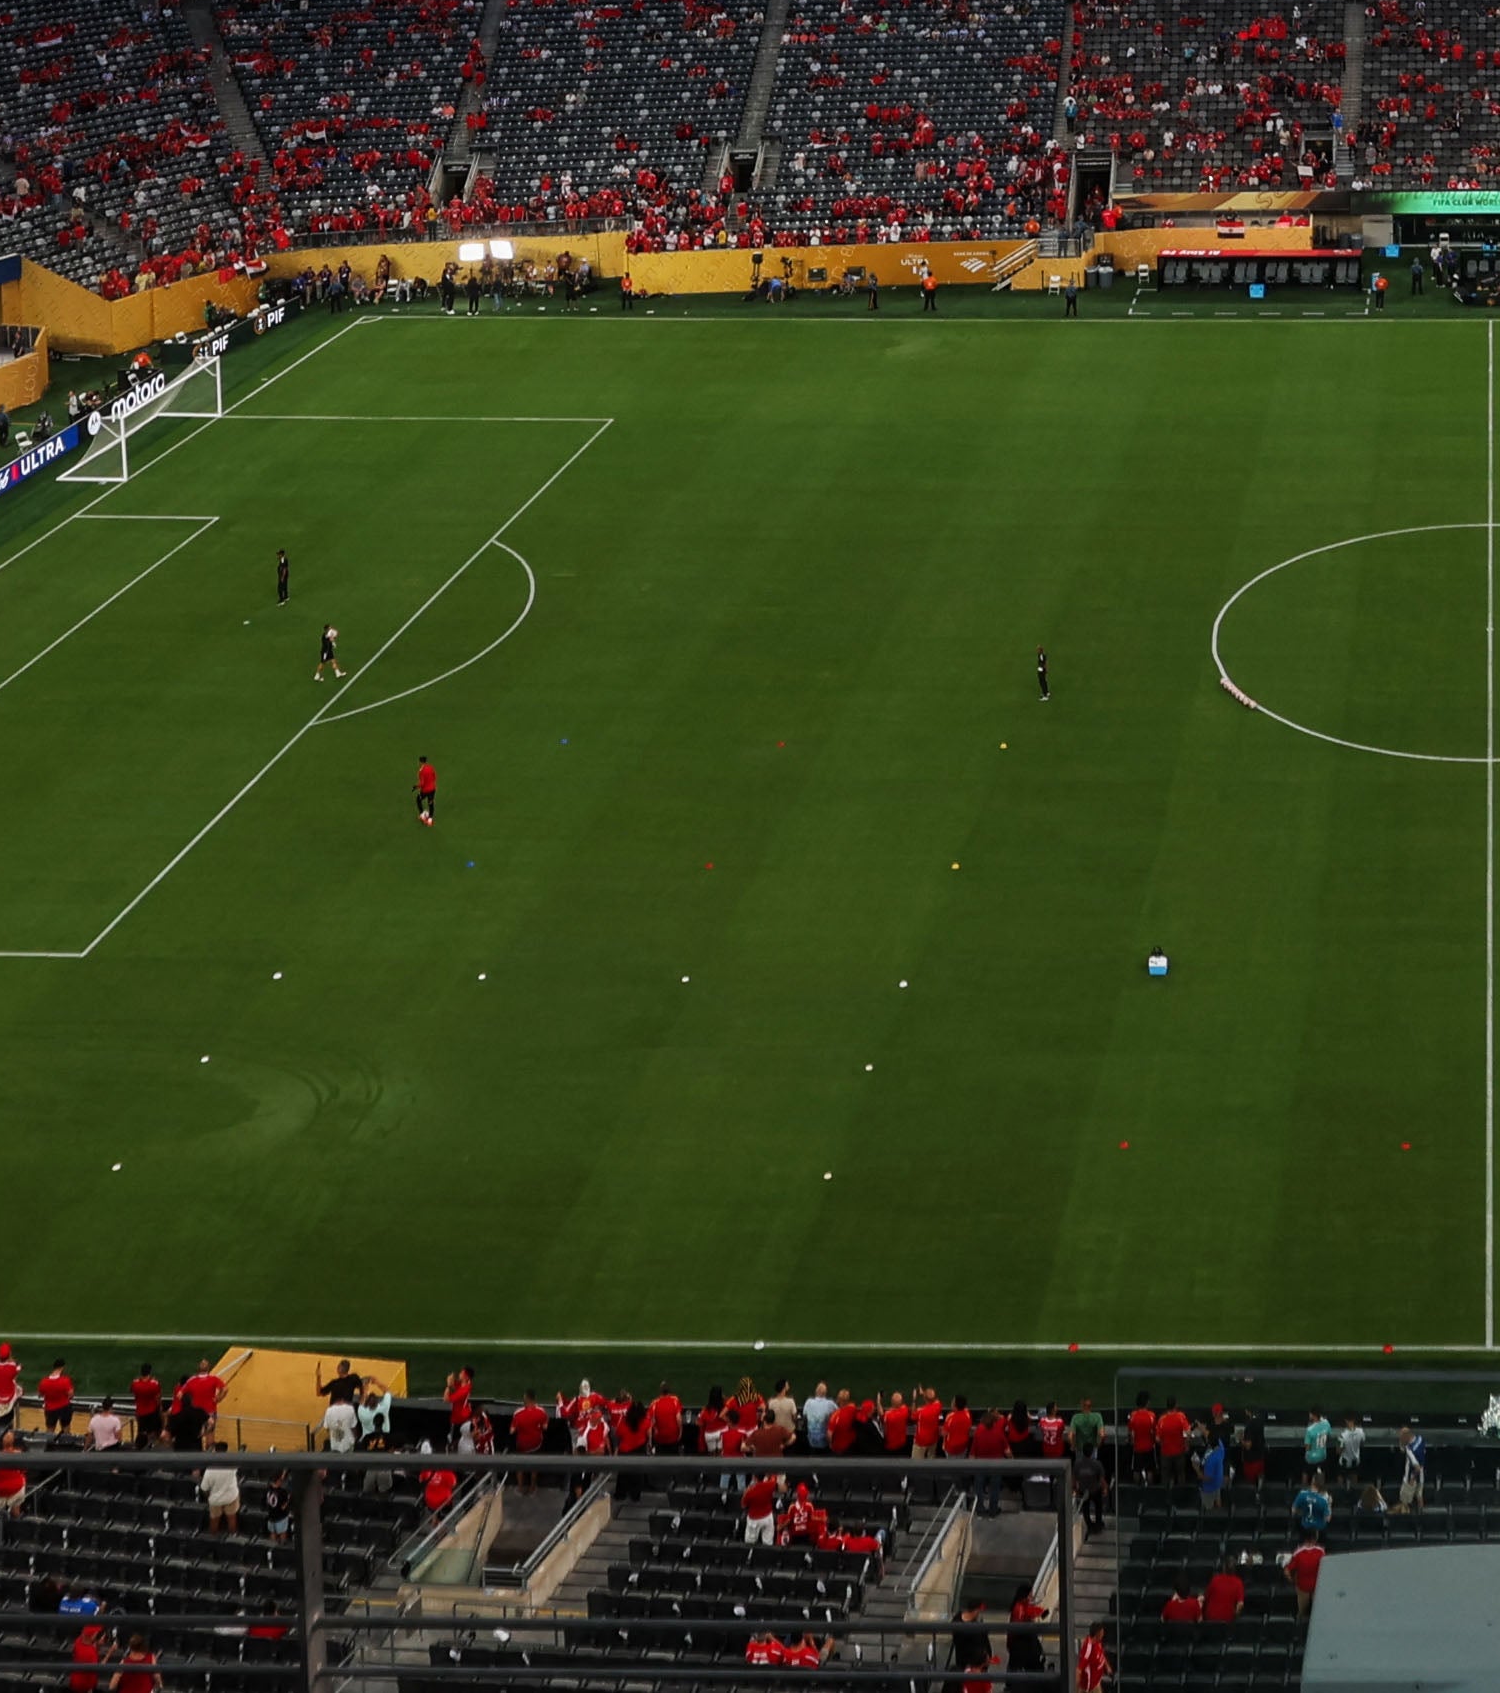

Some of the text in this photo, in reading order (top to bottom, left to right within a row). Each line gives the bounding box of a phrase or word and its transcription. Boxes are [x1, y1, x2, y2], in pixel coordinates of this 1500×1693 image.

[266, 306, 286, 328] PIF
[211, 333, 229, 357] PIF
[20, 432, 65, 476] ULTRA
